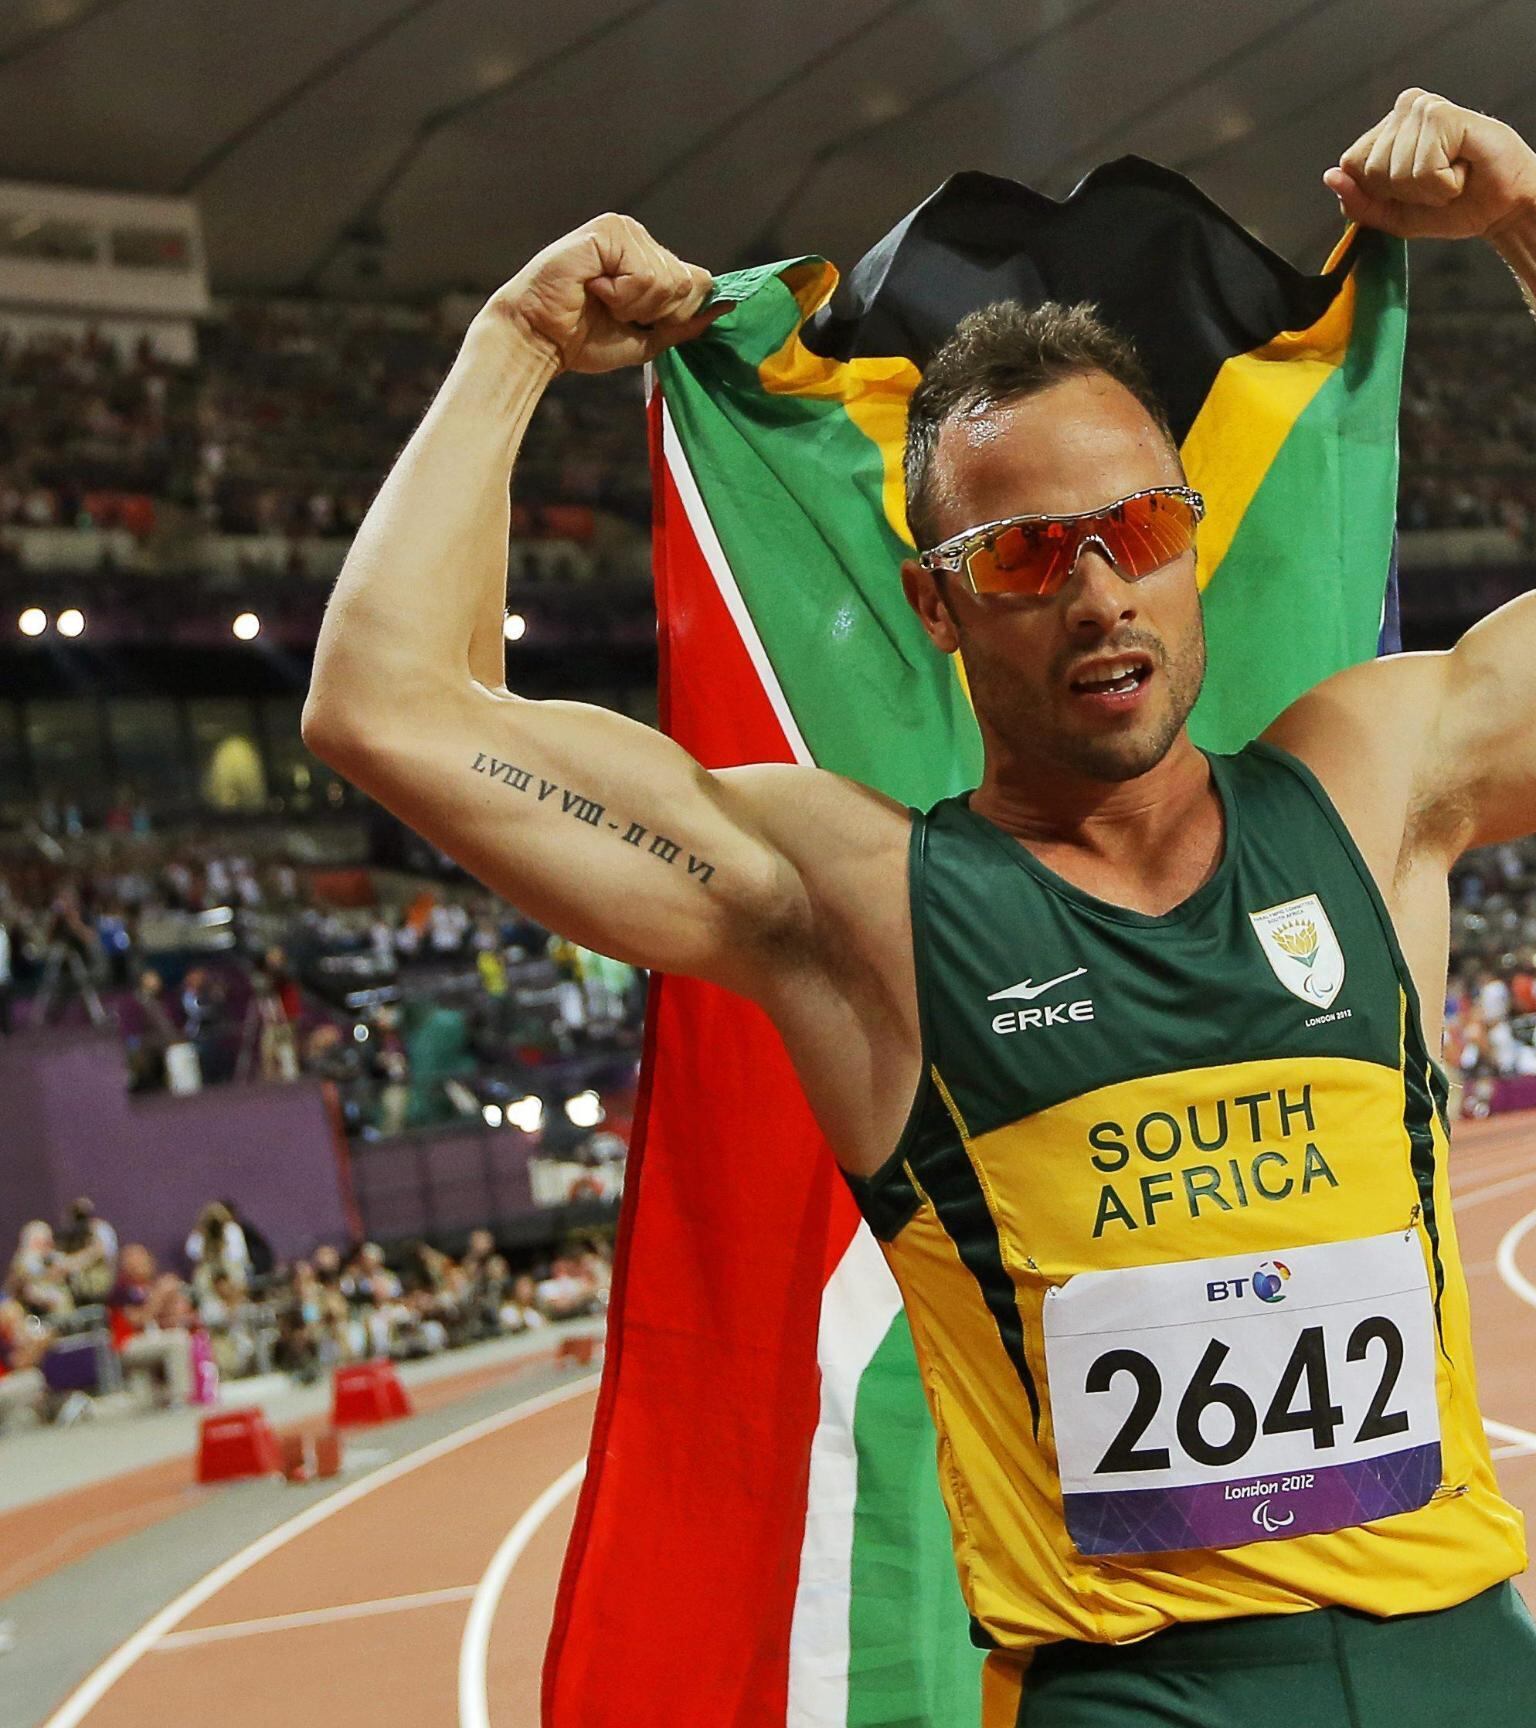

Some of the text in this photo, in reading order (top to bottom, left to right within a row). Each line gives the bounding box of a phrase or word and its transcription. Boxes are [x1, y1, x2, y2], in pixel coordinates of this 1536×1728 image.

[471, 752, 533, 792] LVIII
[537, 780, 557, 801] V
[561, 790, 606, 827] VIII
[622, 822, 648, 847] II
[648, 835, 683, 864] III
[687, 854, 716, 884] VI
[991, 1000, 1095, 1034] ERKE
[1304, 1009, 1352, 1027] LONDON 2012
[1089, 1084, 1316, 1173] SOUTH
[1091, 1142, 1339, 1238] AFRICA
[1207, 1278, 1250, 1302] BT
[1085, 1315, 1410, 1474] 2642
[1224, 1473, 1315, 1500] London 2012
